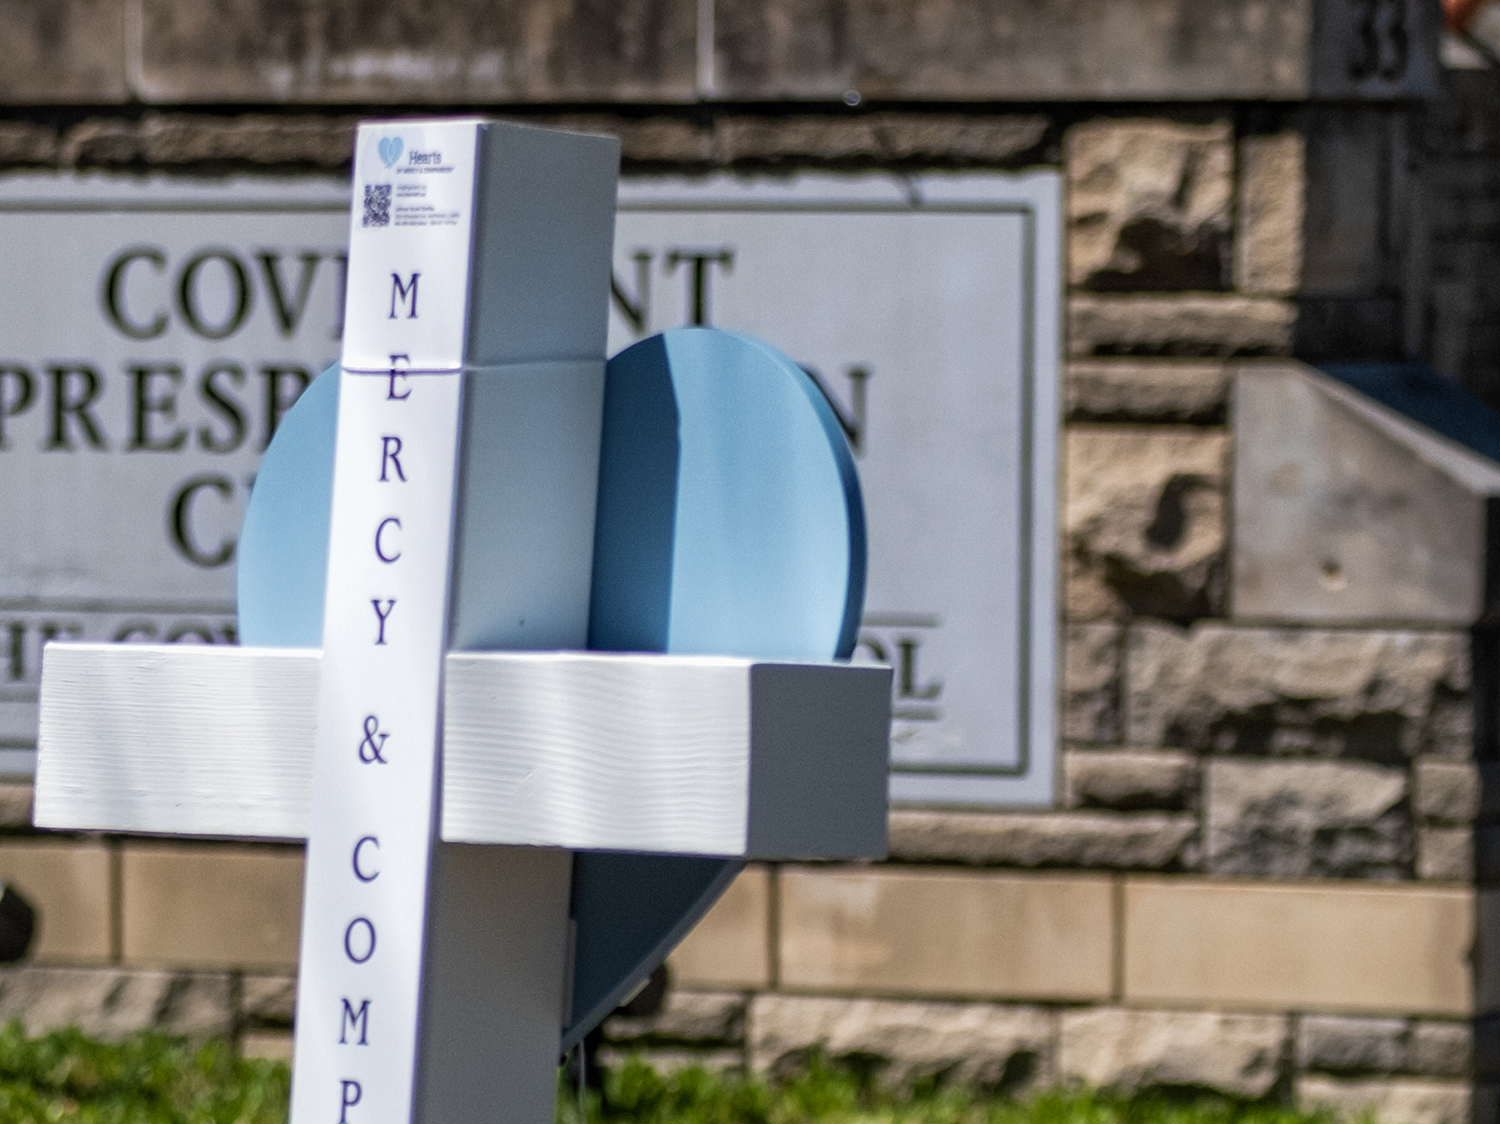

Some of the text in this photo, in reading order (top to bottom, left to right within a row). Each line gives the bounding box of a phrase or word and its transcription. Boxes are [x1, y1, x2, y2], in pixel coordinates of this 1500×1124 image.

[408, 150, 442, 166] Hearts
[101, 243, 735, 341] COVNT
[370, 272, 421, 647] MERCY
[358, 714, 391, 766] &
